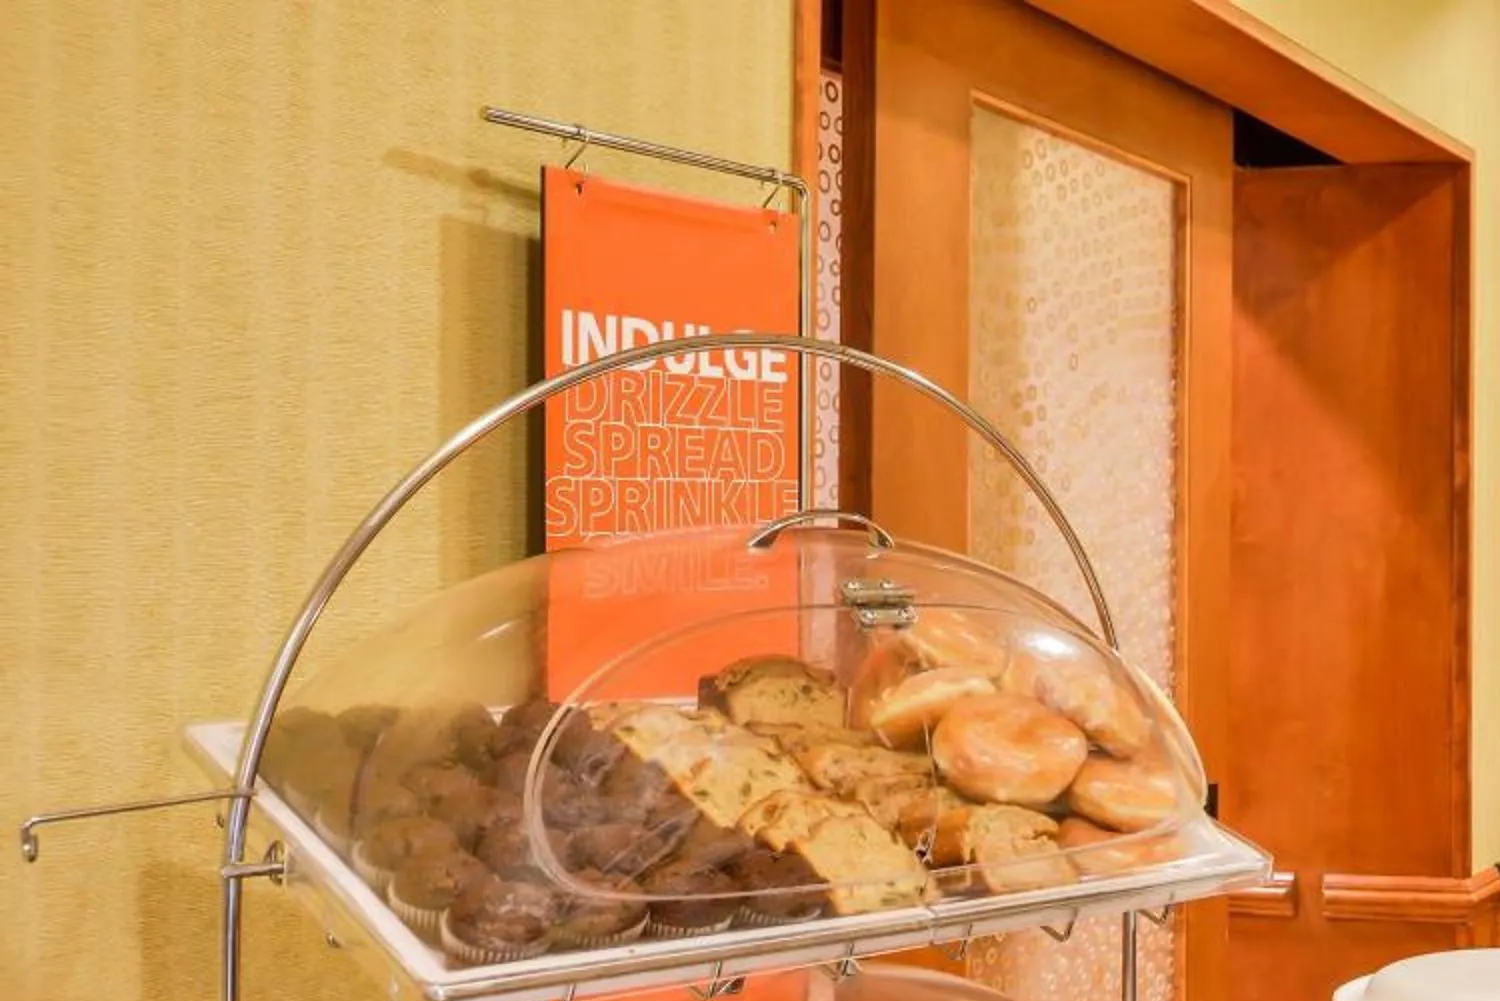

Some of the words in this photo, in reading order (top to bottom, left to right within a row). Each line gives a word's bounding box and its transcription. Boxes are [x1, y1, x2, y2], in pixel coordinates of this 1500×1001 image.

[561, 309, 787, 383] INDULGE
[564, 368, 785, 432] DRIZZLE
[563, 420, 786, 483] SPREAD
[545, 476, 799, 538] SPRINKLE
